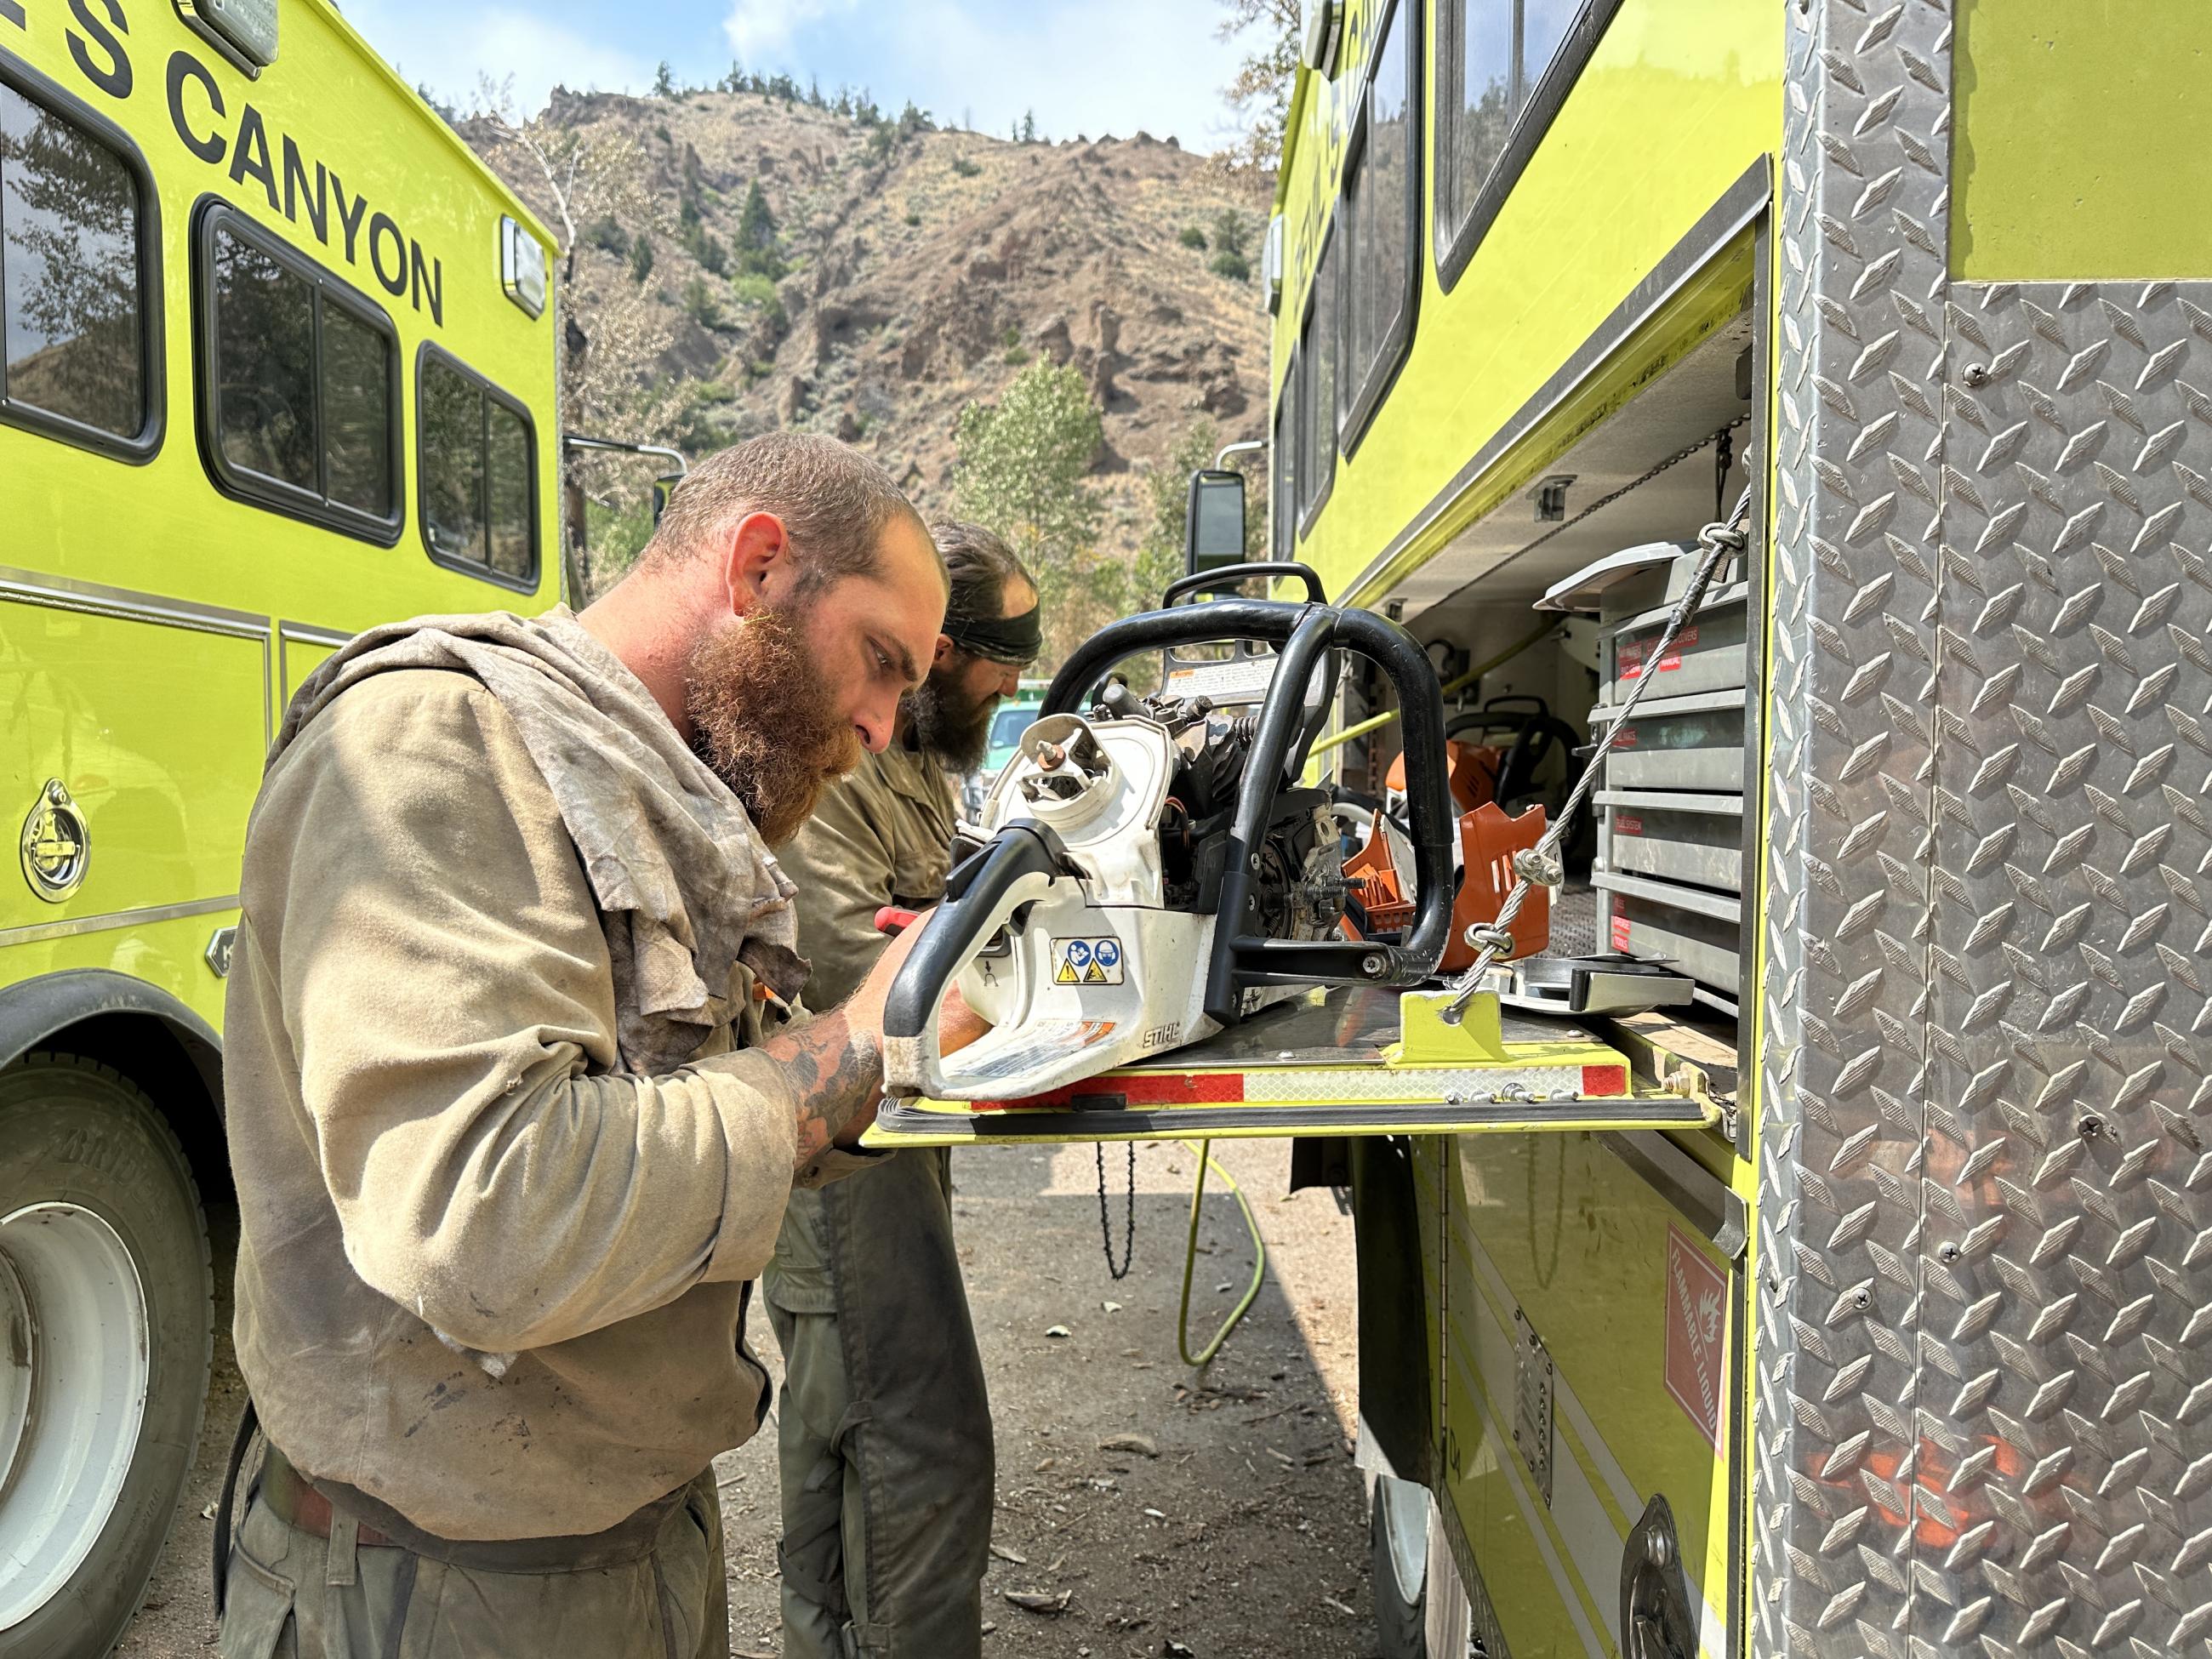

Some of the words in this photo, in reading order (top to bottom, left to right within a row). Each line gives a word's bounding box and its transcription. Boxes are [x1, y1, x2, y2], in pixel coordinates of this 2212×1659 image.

[166, 50, 443, 328] CANYON
[1614, 935, 1628, 950] TOOLS
[1143, 1023, 1180, 1047] STIHL
[1670, 1246, 1702, 1362] FLAMMABLE
[1696, 1361, 1718, 1431] LIQUID
